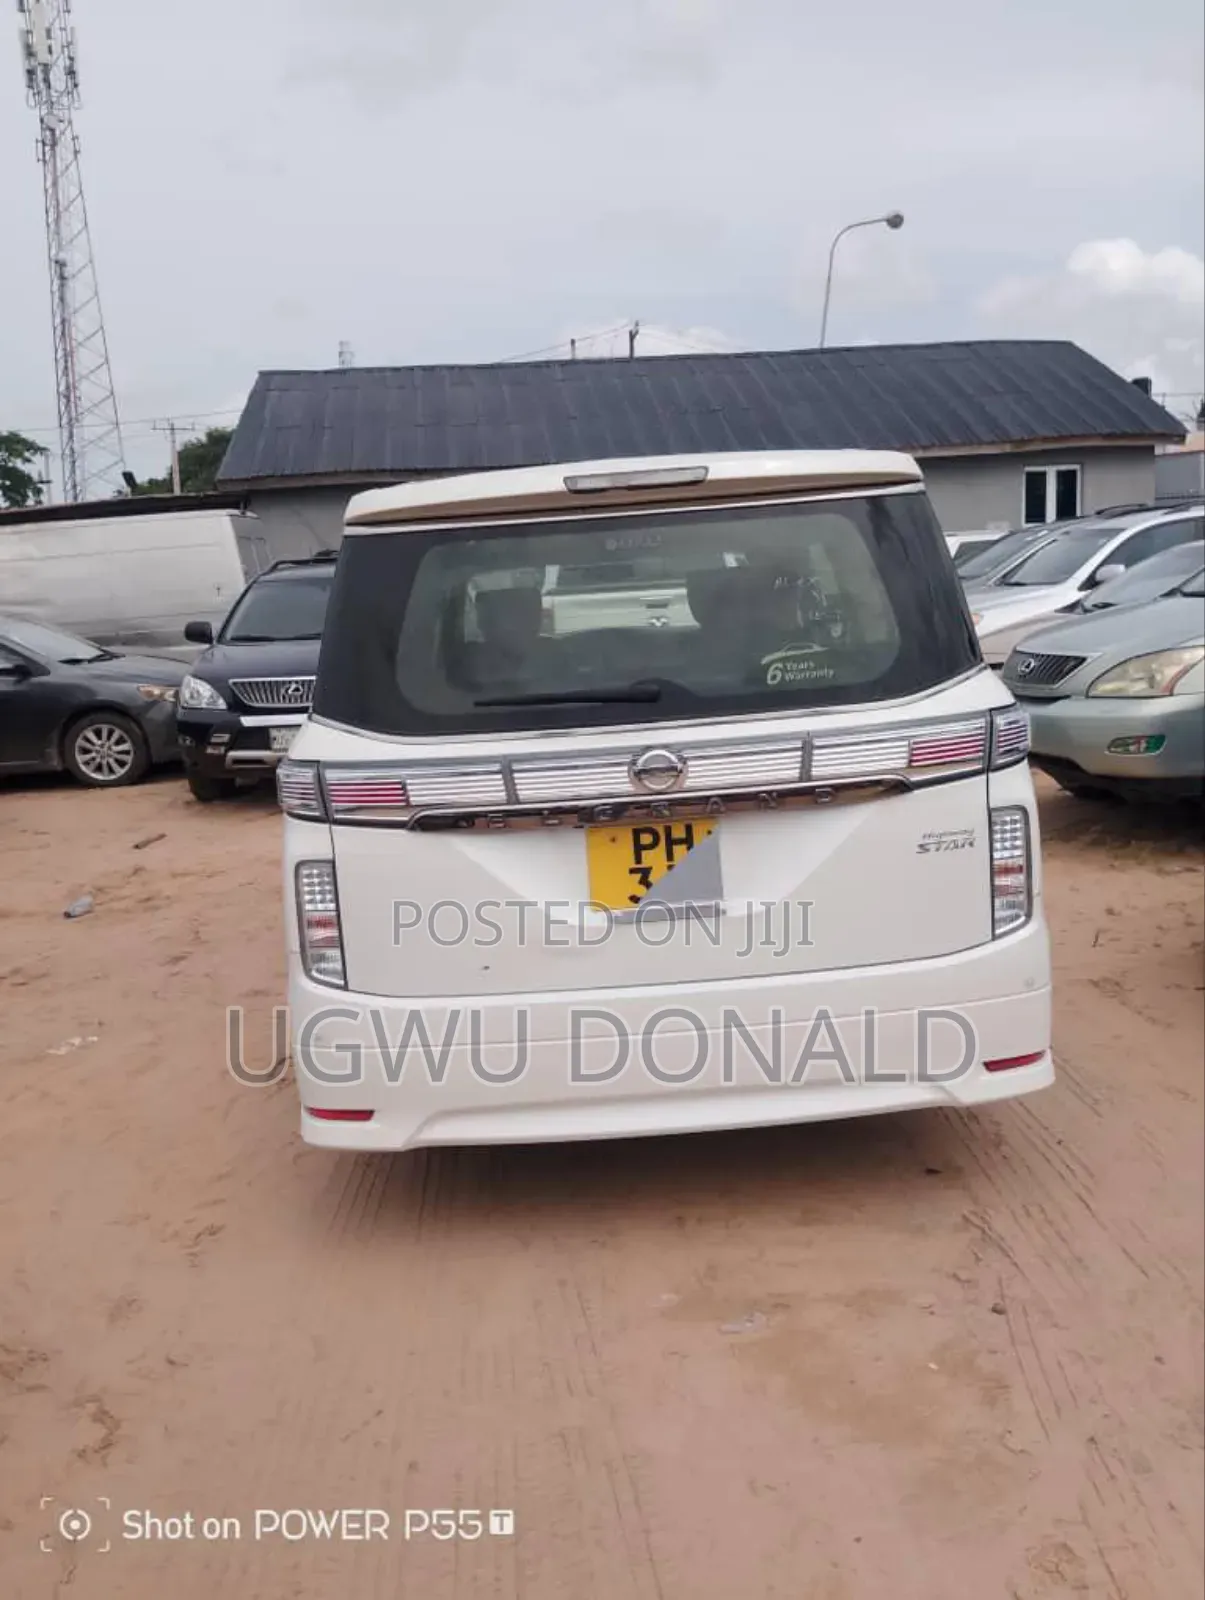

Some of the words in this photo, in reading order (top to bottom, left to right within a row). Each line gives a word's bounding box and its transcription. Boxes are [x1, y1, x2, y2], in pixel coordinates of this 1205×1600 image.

[766, 662, 783, 685] 6
[784, 666, 835, 682] Warranty
[632, 822, 694, 865] PH
[915, 838, 976, 854] STAR
